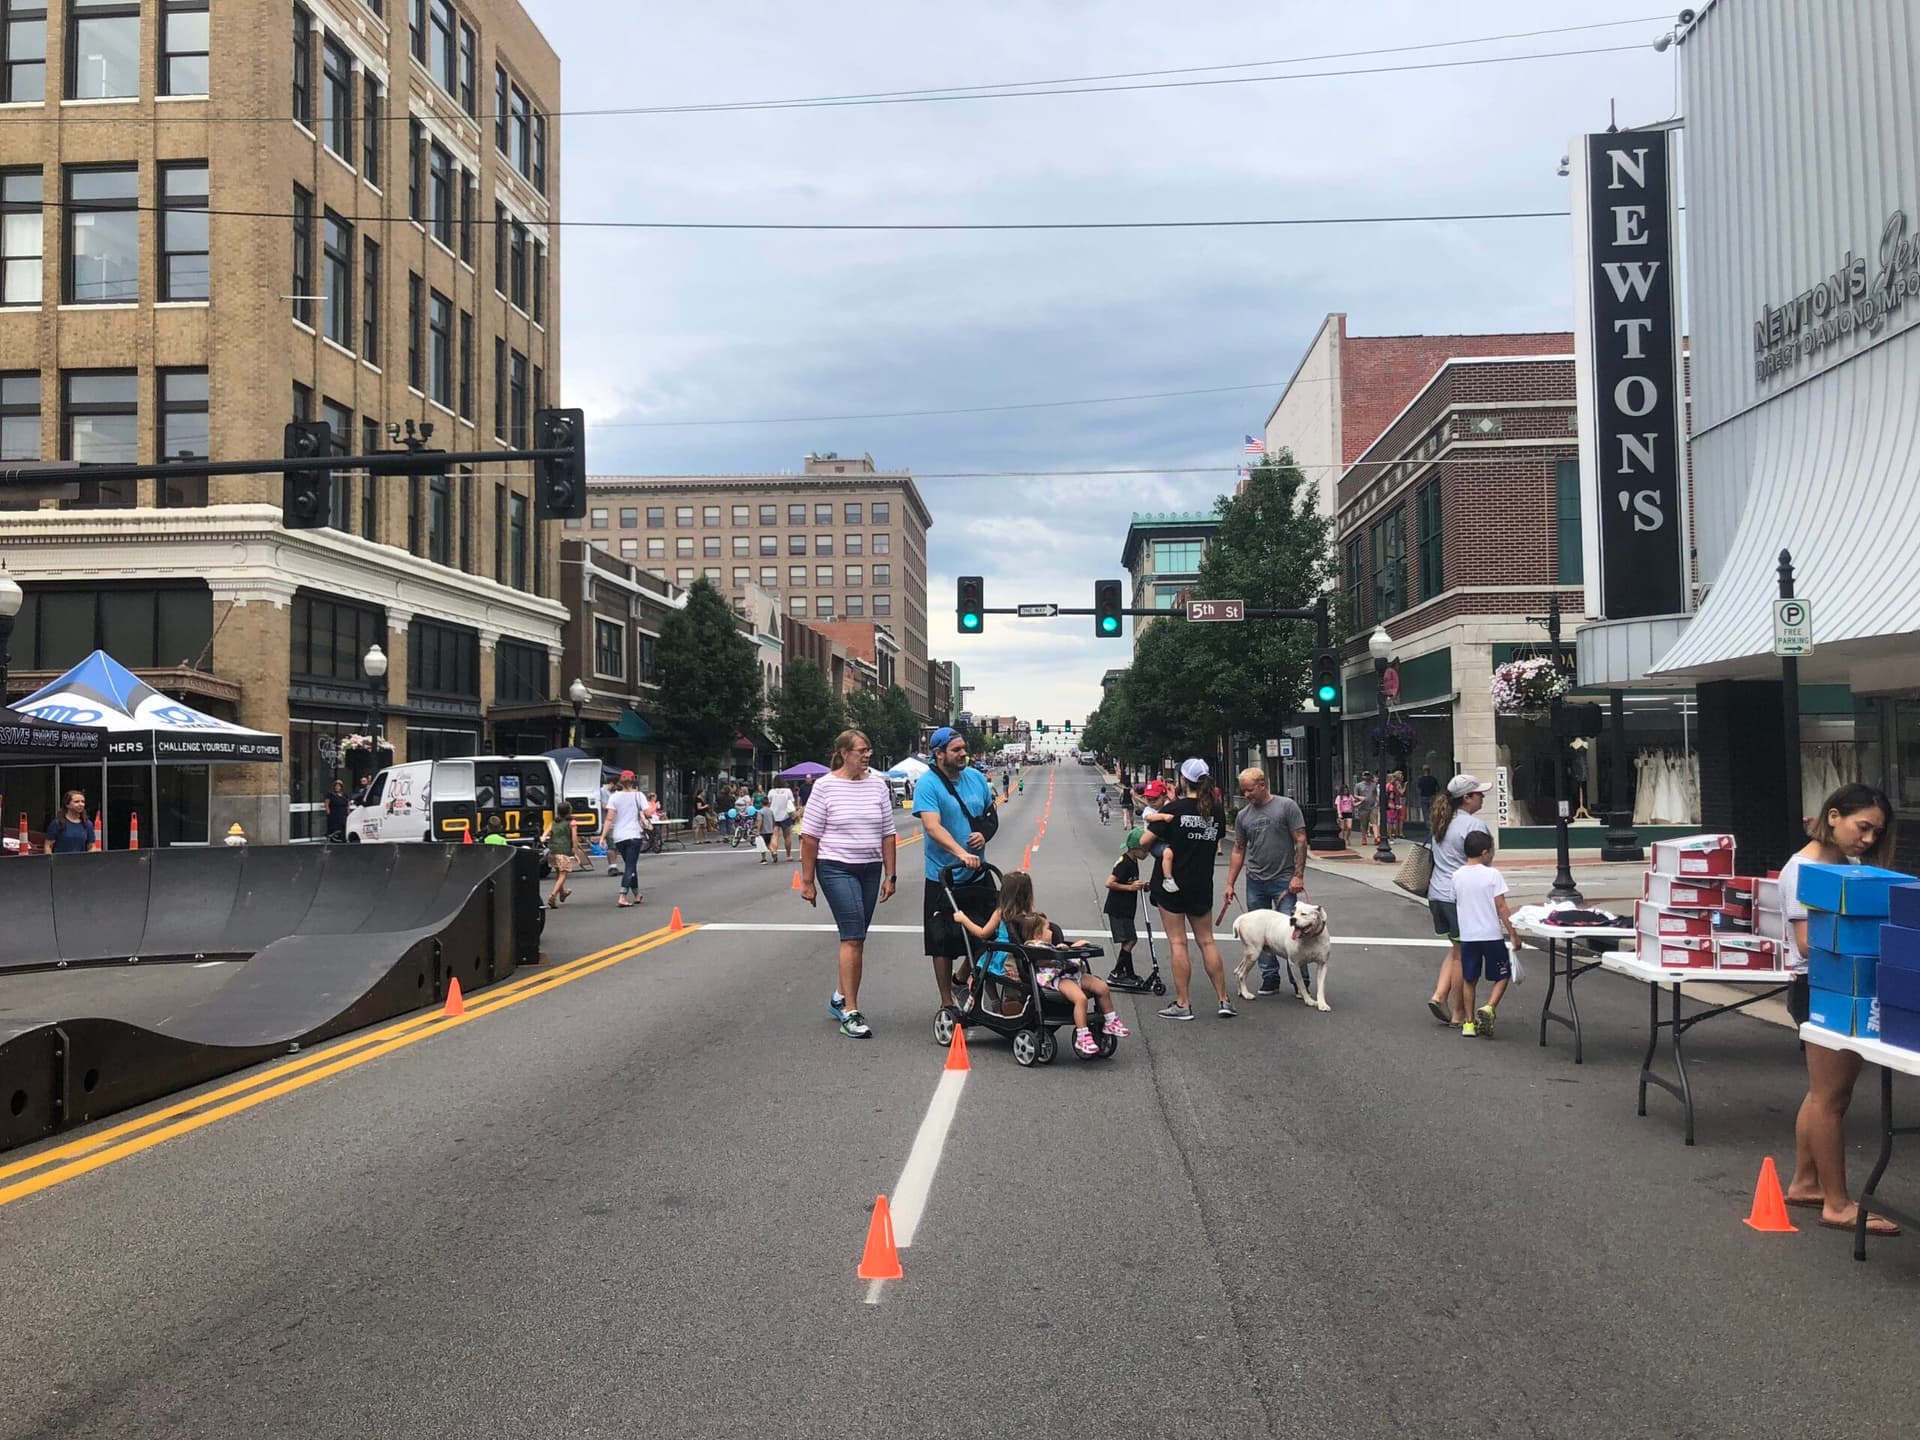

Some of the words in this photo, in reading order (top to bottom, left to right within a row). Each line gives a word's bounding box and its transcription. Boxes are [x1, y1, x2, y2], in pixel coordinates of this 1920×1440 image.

[1754, 250, 1867, 353] NEWTON'S
[1600, 148, 1664, 533] NEWTON'S
[1755, 340, 1800, 383] DIRECT
[1803, 300, 1873, 356] DIAMOND
[1192, 603, 1215, 619] 5th
[1225, 606, 1239, 619] St
[1777, 636, 1809, 645] PARKING
[1783, 628, 1802, 636] FREE
[60, 730, 98, 750] RAMPS
[158, 741, 200, 752] CHALLENGE
[201, 743, 235, 753] YOURSELF
[239, 745, 255, 754] HELP
[256, 746, 280, 755] OTHERS
